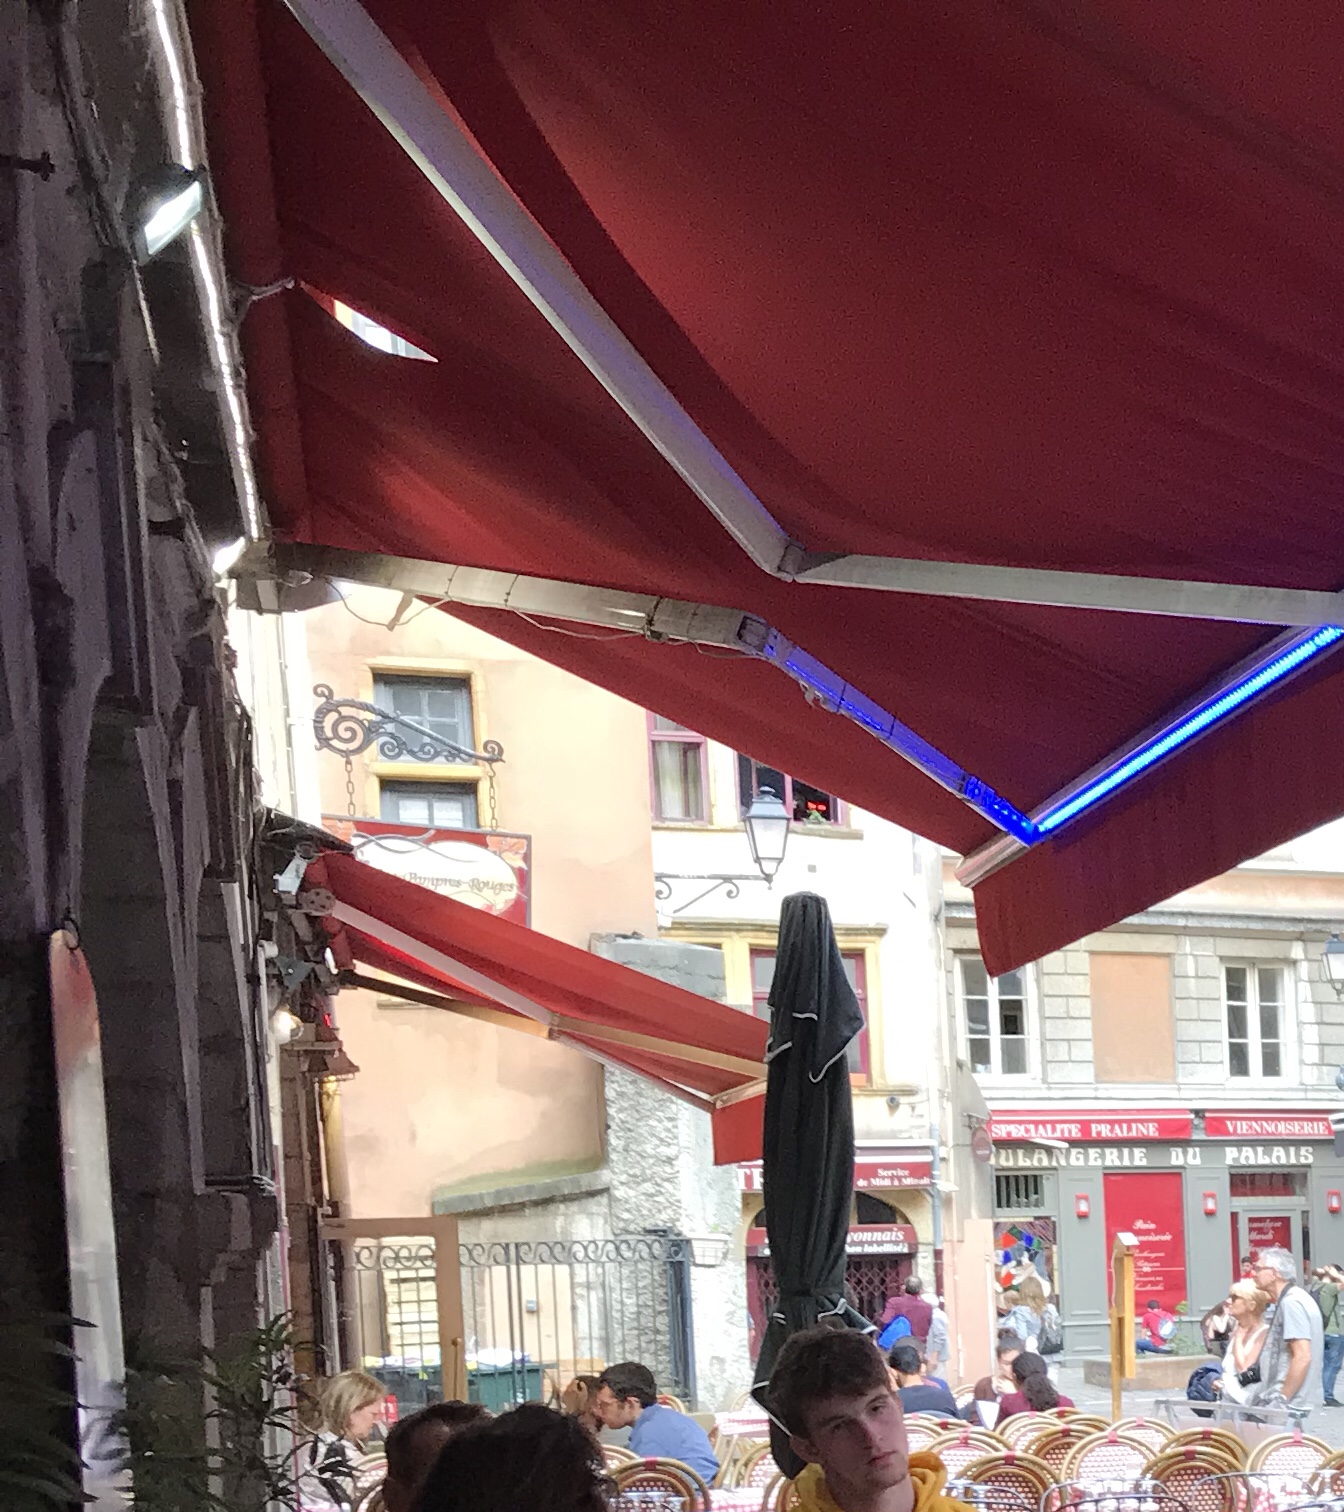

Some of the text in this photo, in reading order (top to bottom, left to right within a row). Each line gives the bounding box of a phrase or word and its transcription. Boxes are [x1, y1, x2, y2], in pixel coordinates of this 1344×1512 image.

[991, 1122, 1159, 1138] SPECIALITE PRALINE
[1225, 1120, 1329, 1135] VIENNOISERIE
[1169, 1147, 1201, 1166] DU
[1224, 1146, 1314, 1165] PALAIS
